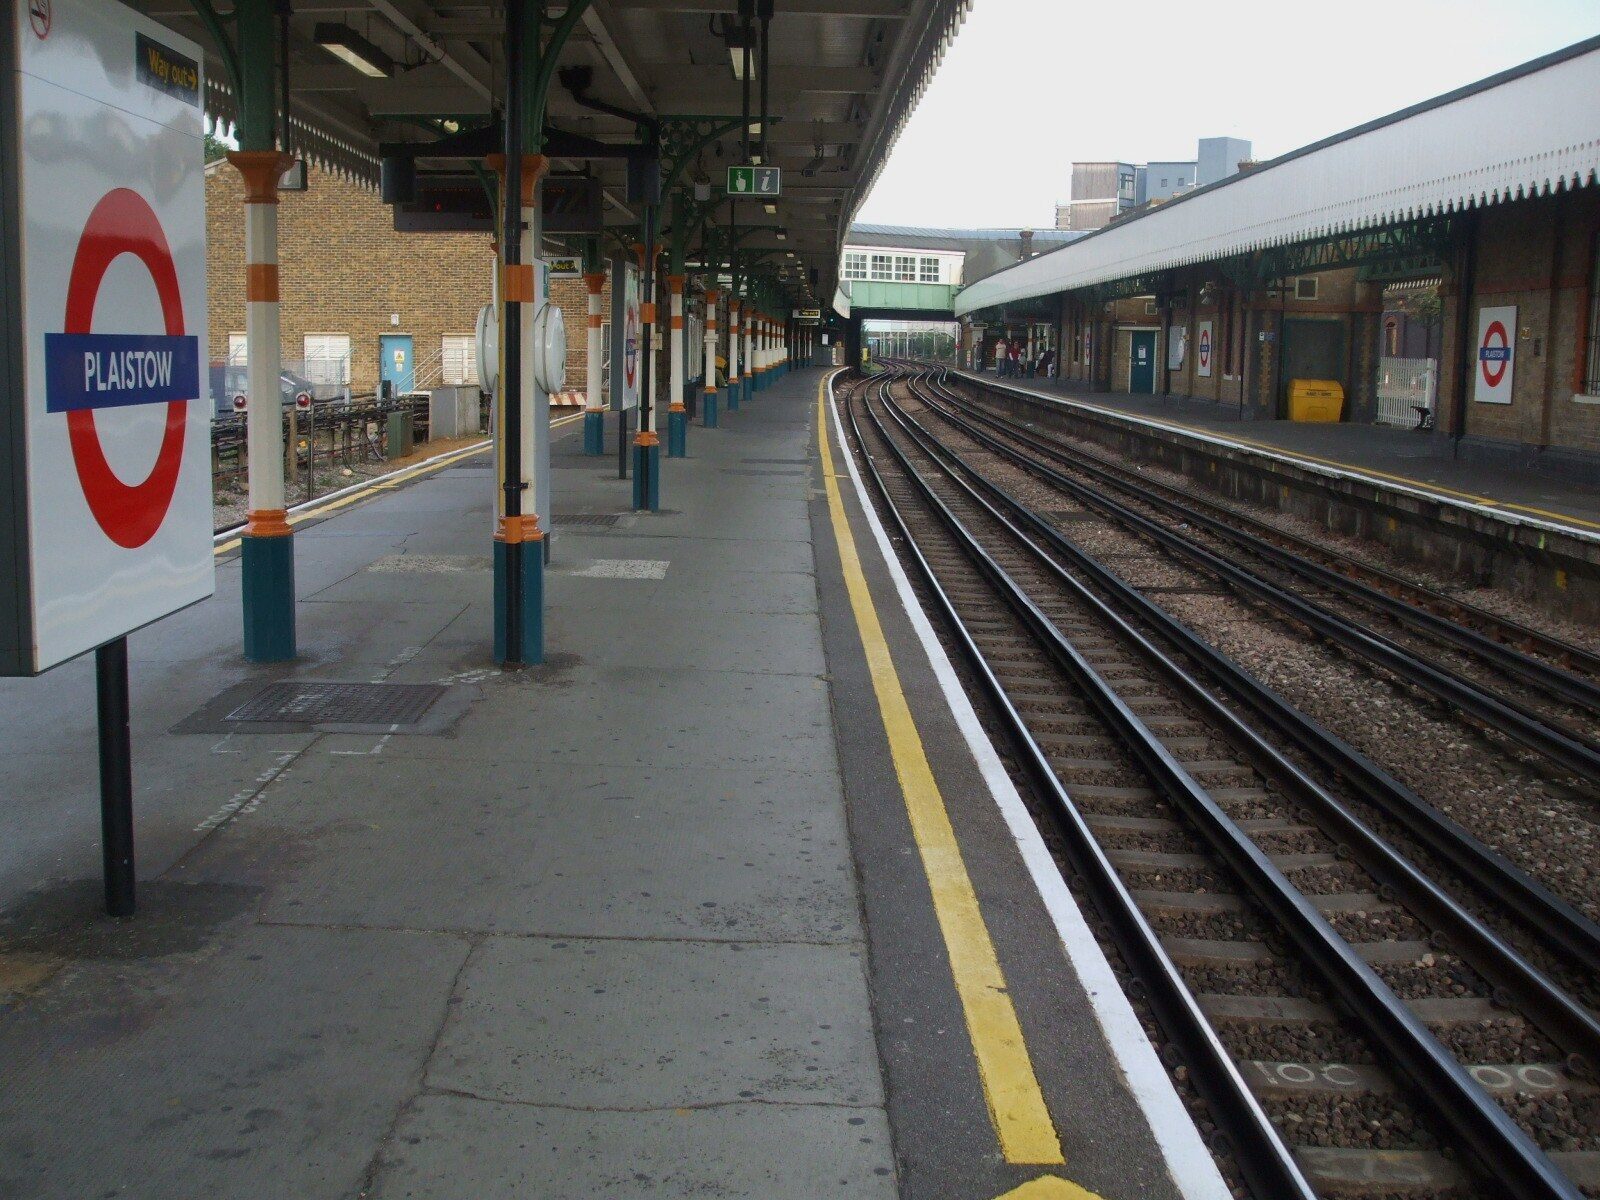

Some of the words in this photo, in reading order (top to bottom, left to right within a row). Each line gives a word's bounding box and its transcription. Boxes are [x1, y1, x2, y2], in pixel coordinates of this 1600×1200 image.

[147, 47, 168, 83] Way
[171, 65, 188, 86] out
[84, 350, 173, 392] PLAISTOW
